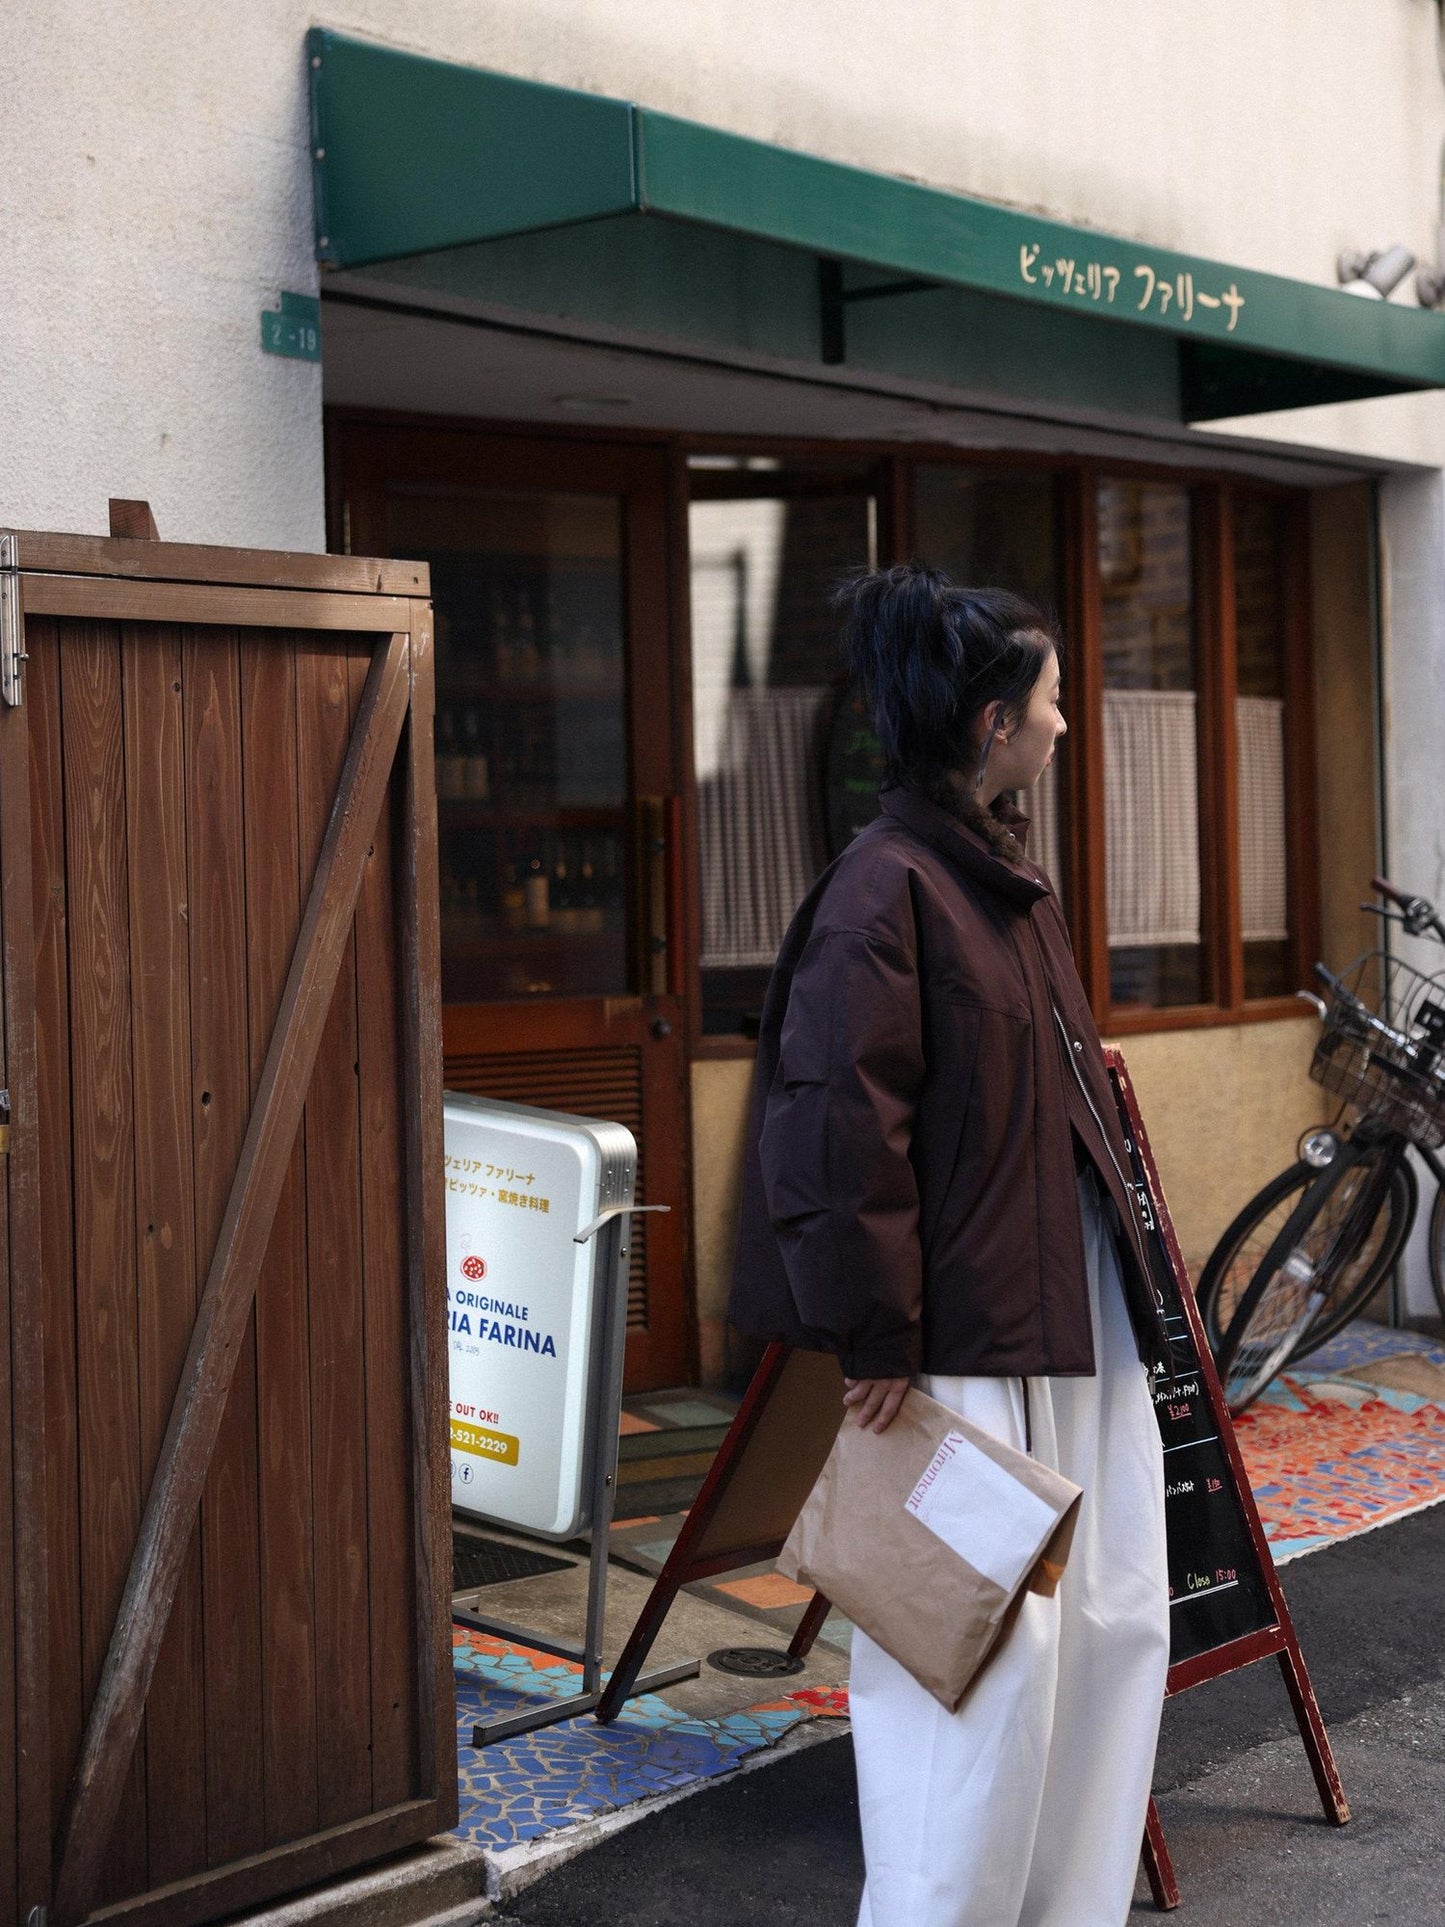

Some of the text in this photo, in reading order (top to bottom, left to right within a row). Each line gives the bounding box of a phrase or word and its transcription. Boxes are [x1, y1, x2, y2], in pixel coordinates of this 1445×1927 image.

[1020, 243, 1245, 332] ピッツェリア ファリーナ
[486, 1164, 536, 1186] ファリーナ
[456, 1290, 529, 1321] ORIGINALE
[479, 1318, 557, 1358] FARINA
[456, 1402, 476, 1418] OUT
[479, 1409, 500, 1424] OK!!
[1187, 1568, 1237, 1590] Close 15:00
